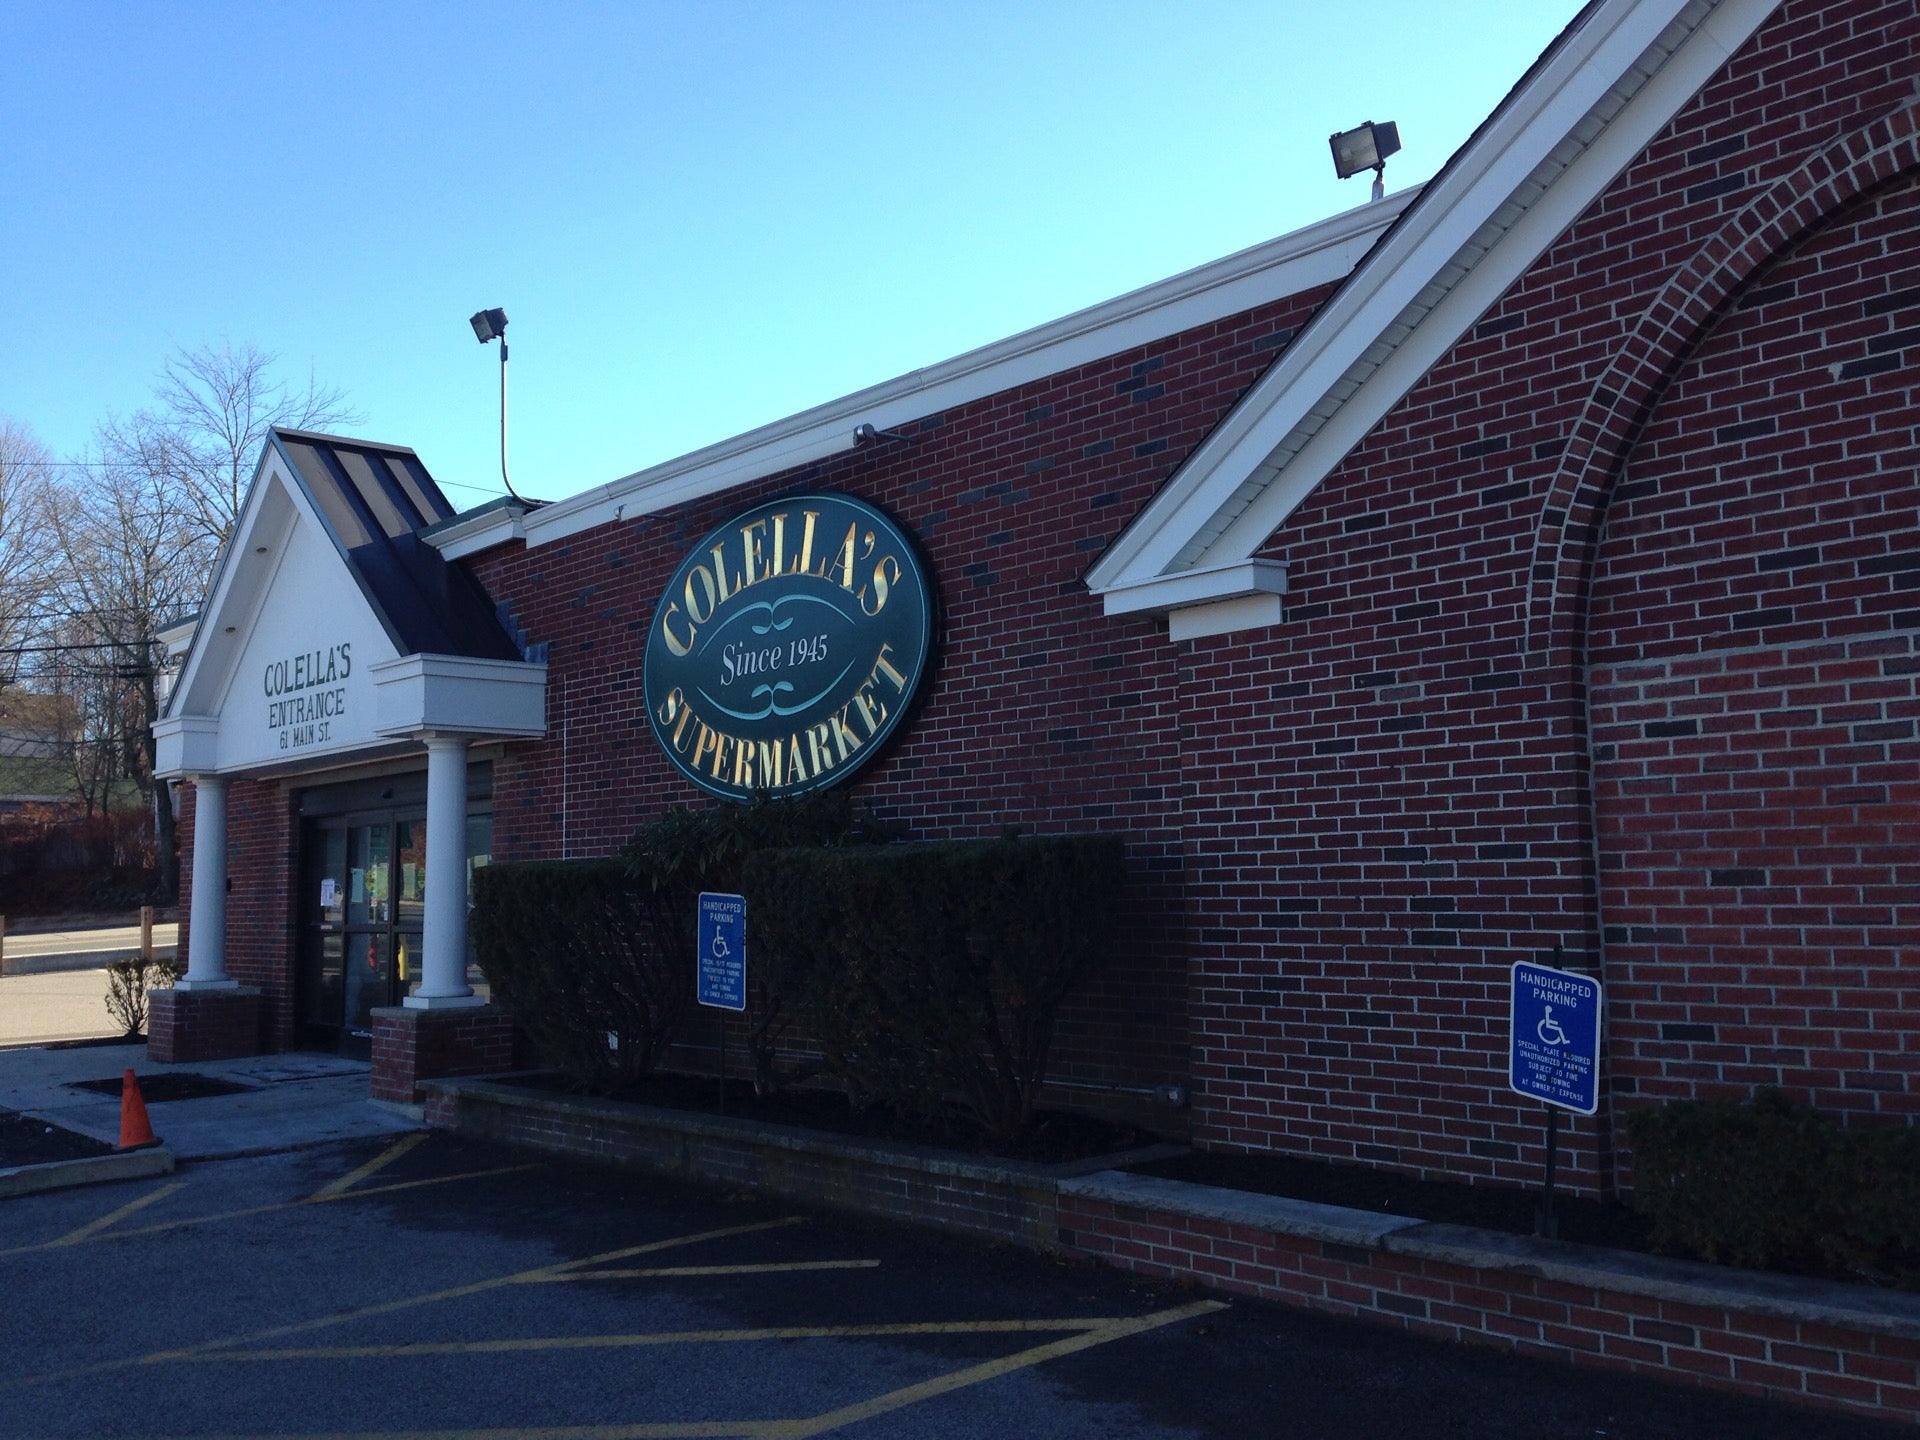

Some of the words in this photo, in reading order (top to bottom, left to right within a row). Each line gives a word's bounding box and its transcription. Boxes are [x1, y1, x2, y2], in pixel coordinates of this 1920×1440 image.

[662, 510, 903, 657] COLELLA'S
[264, 643, 351, 698] COLELLA'S
[720, 641, 782, 686] Since
[787, 633, 829, 668] 1945
[269, 688, 345, 729] ENTRANCE
[657, 642, 909, 790] SUPERMARKET
[279, 730, 288, 750] 61
[293, 724, 314, 748] MAIN
[318, 721, 331, 743] ST.
[703, 901, 741, 913] HANDICAPPED
[709, 912, 734, 924] PARKING
[1520, 971, 1592, 999] HANDICAPPED
[1533, 988, 1577, 1008] PARKING
[1517, 1039, 1540, 1052] SPECIAL
[1543, 1046, 1560, 1057] PLATE
[1519, 1049, 1561, 1068] UNAUTHORIZED
[1563, 1061, 1588, 1075] PARKING
[1527, 1061, 1552, 1074] SUBJECT
[1565, 1071, 1579, 1082] FINE
[1521, 1077, 1529, 1086] AT
[1559, 1088, 1584, 1103] EXPENSE
[1535, 1072, 1547, 1082] AND
